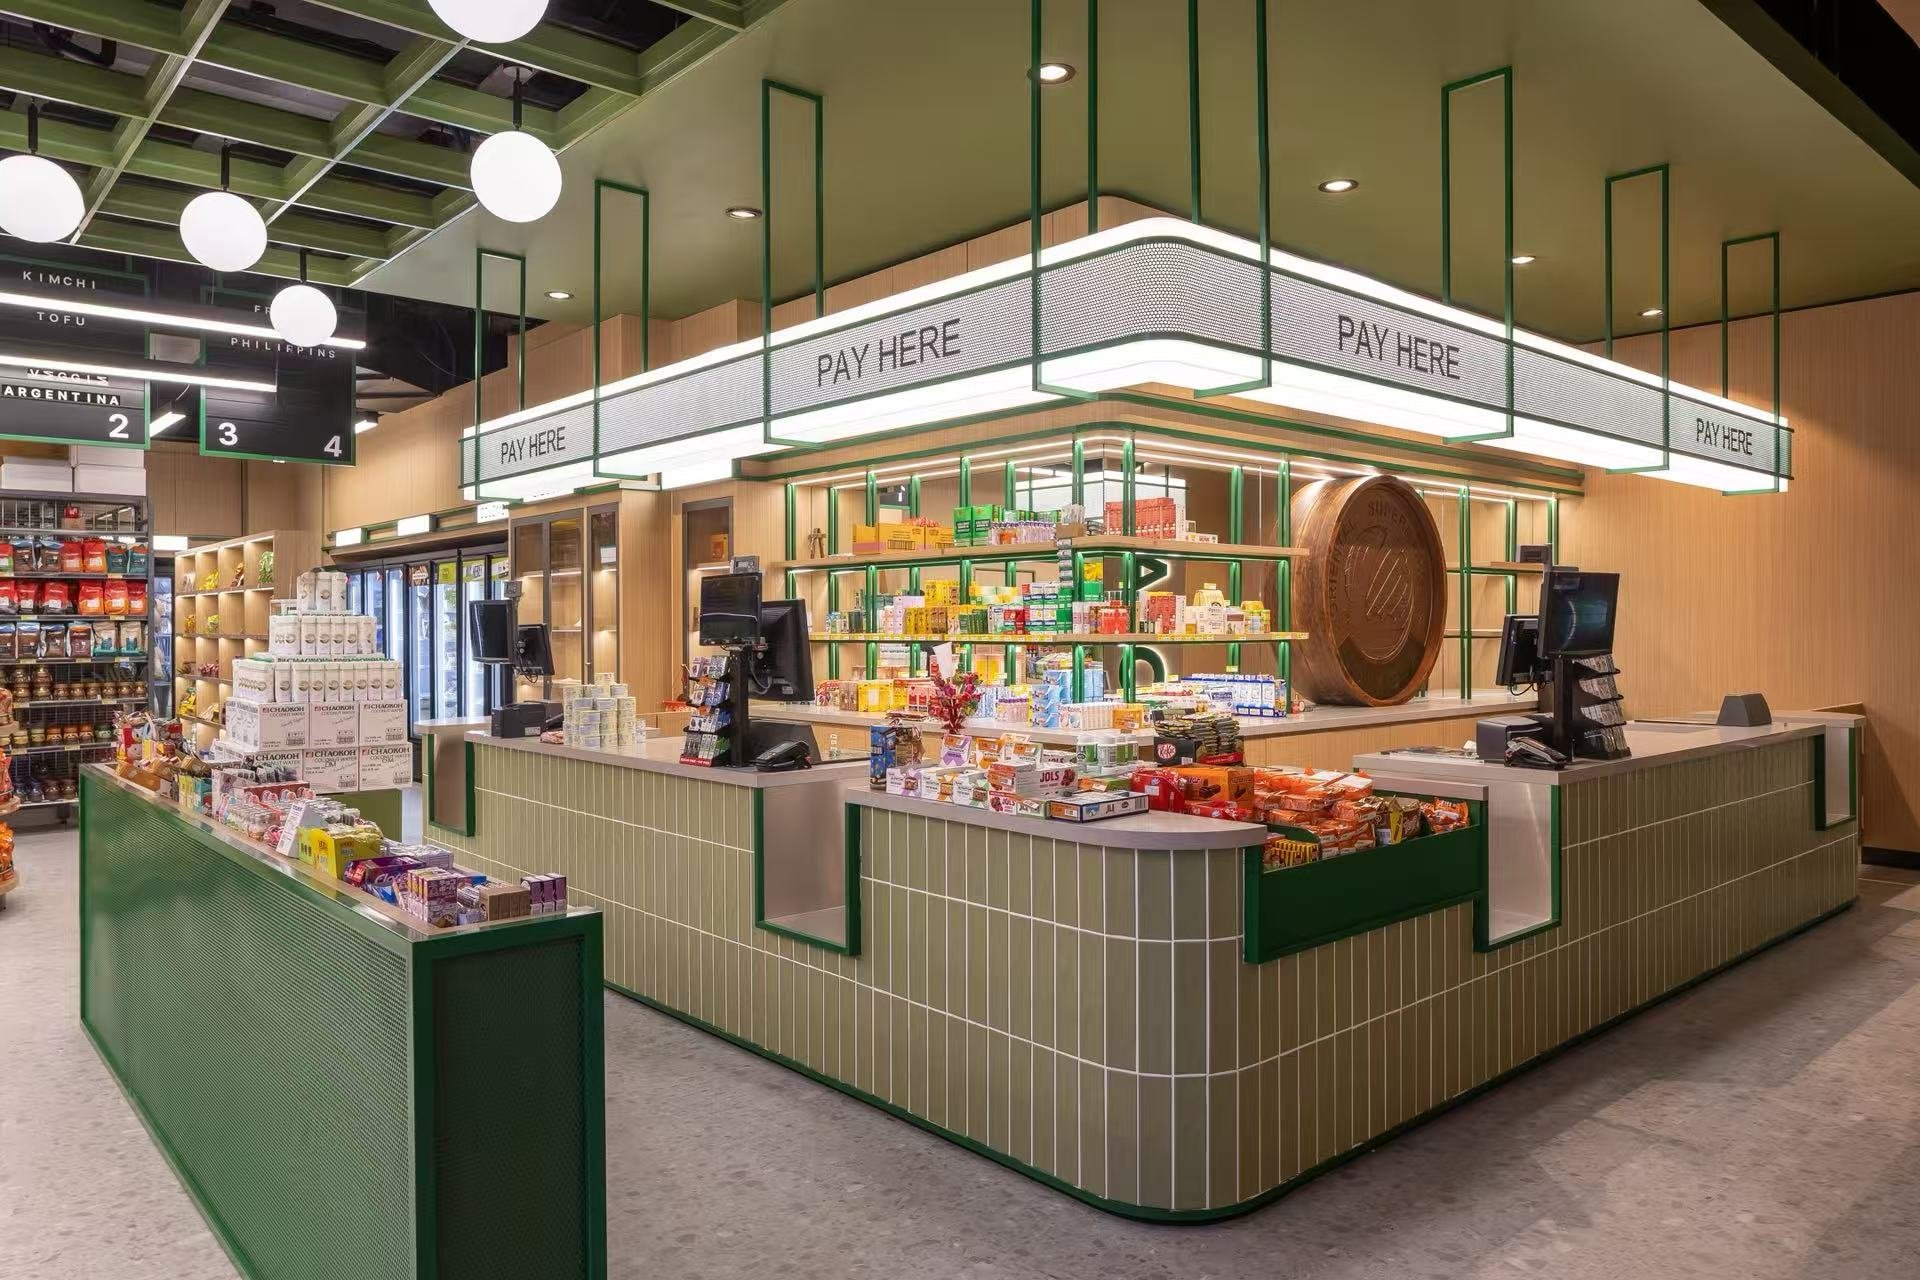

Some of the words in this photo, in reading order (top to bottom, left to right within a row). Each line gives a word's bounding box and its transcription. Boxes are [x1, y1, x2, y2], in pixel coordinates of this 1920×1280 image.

[23, 271, 96, 290] KIMCHI
[36, 311, 85, 326] TOFU
[818, 343, 869, 387] PAY
[879, 318, 961, 372] HERE
[1338, 314, 1389, 360] PAY
[1396, 331, 1460, 380] HERE
[4, 385, 119, 405] ARGENTINA
[108, 413, 129, 439] 2
[218, 421, 239, 446] 3
[1696, 417, 1719, 447] PAY
[1722, 425, 1752, 455] HERE
[323, 435, 343, 457] 4
[501, 437, 525, 464] PAY
[529, 426, 566, 458] HERE
[255, 753, 300, 761] CHAOKOH
[314, 749, 356, 757] CHAOKOH
[370, 747, 410, 755] CHAOKOH
[1039, 770, 1060, 783] JOLS
